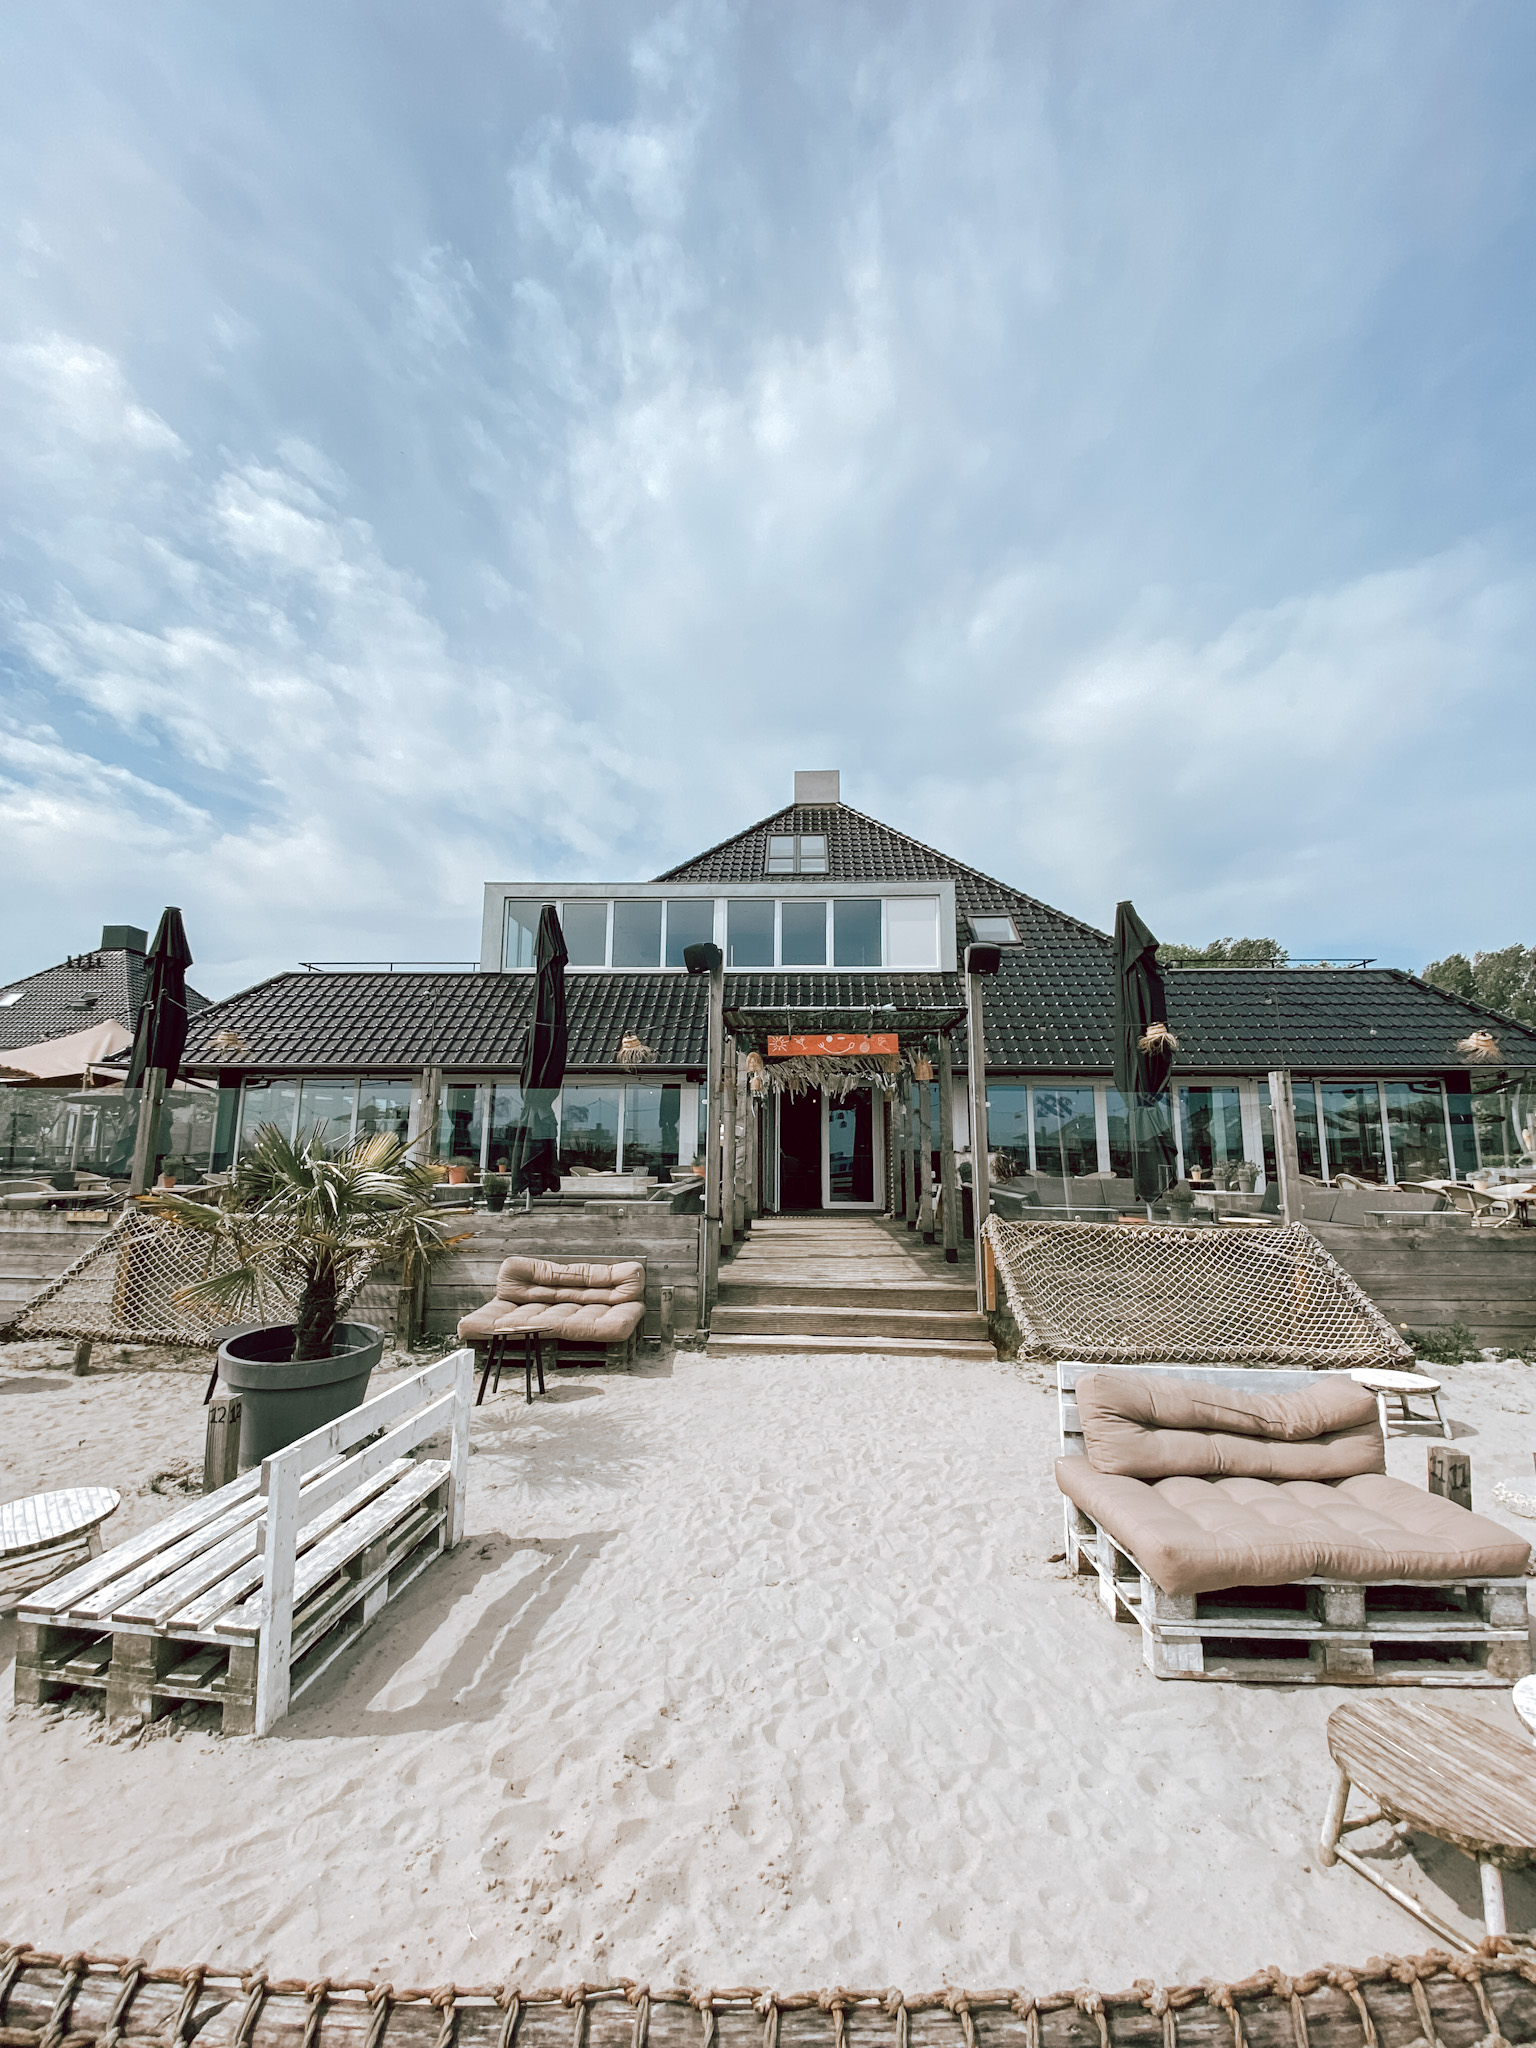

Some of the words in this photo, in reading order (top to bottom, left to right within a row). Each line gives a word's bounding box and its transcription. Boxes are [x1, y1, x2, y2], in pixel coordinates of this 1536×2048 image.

[209, 1406, 227, 1424] 12
[229, 1402, 242, 1424] 12
[1430, 1455, 1446, 1483] 11
[1449, 1463, 1469, 1490] 11
